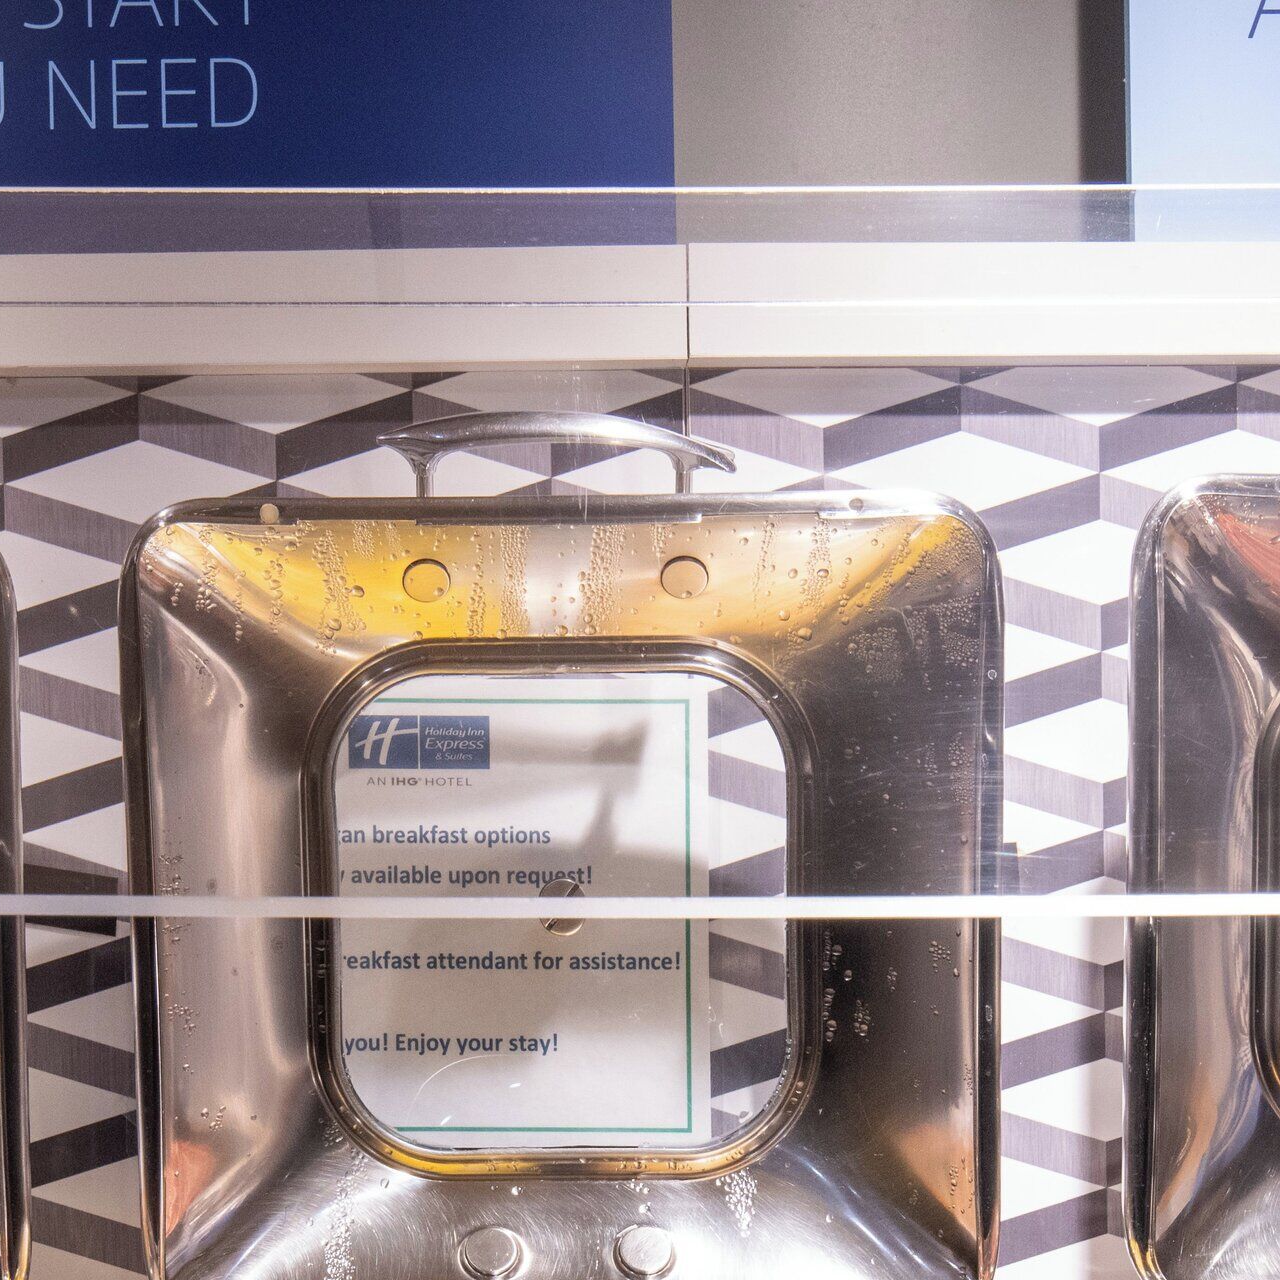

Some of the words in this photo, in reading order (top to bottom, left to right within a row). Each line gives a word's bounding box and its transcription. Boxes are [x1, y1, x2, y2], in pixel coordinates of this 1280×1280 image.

[48, 57, 258, 129] NEED
[425, 727, 466, 737] Holiday
[467, 727, 485, 736] Inn
[425, 737, 485, 751] Express
[367, 777, 386, 786] AN
[425, 777, 472, 786] HOTEL
[372, 825, 468, 844] breakfast
[474, 825, 551, 848] options
[351, 865, 442, 884] available
[449, 869, 500, 889] upon
[507, 865, 592, 888] request!
[344, 951, 420, 970] eakfast
[426, 951, 528, 970] attendant
[533, 951, 563, 970] for
[569, 951, 681, 971] assistance!
[345, 1033, 388, 1055] you!
[395, 1034, 449, 1055] Enjoy
[457, 1038, 503, 1055] your
[509, 1033, 558, 1055] stay!
